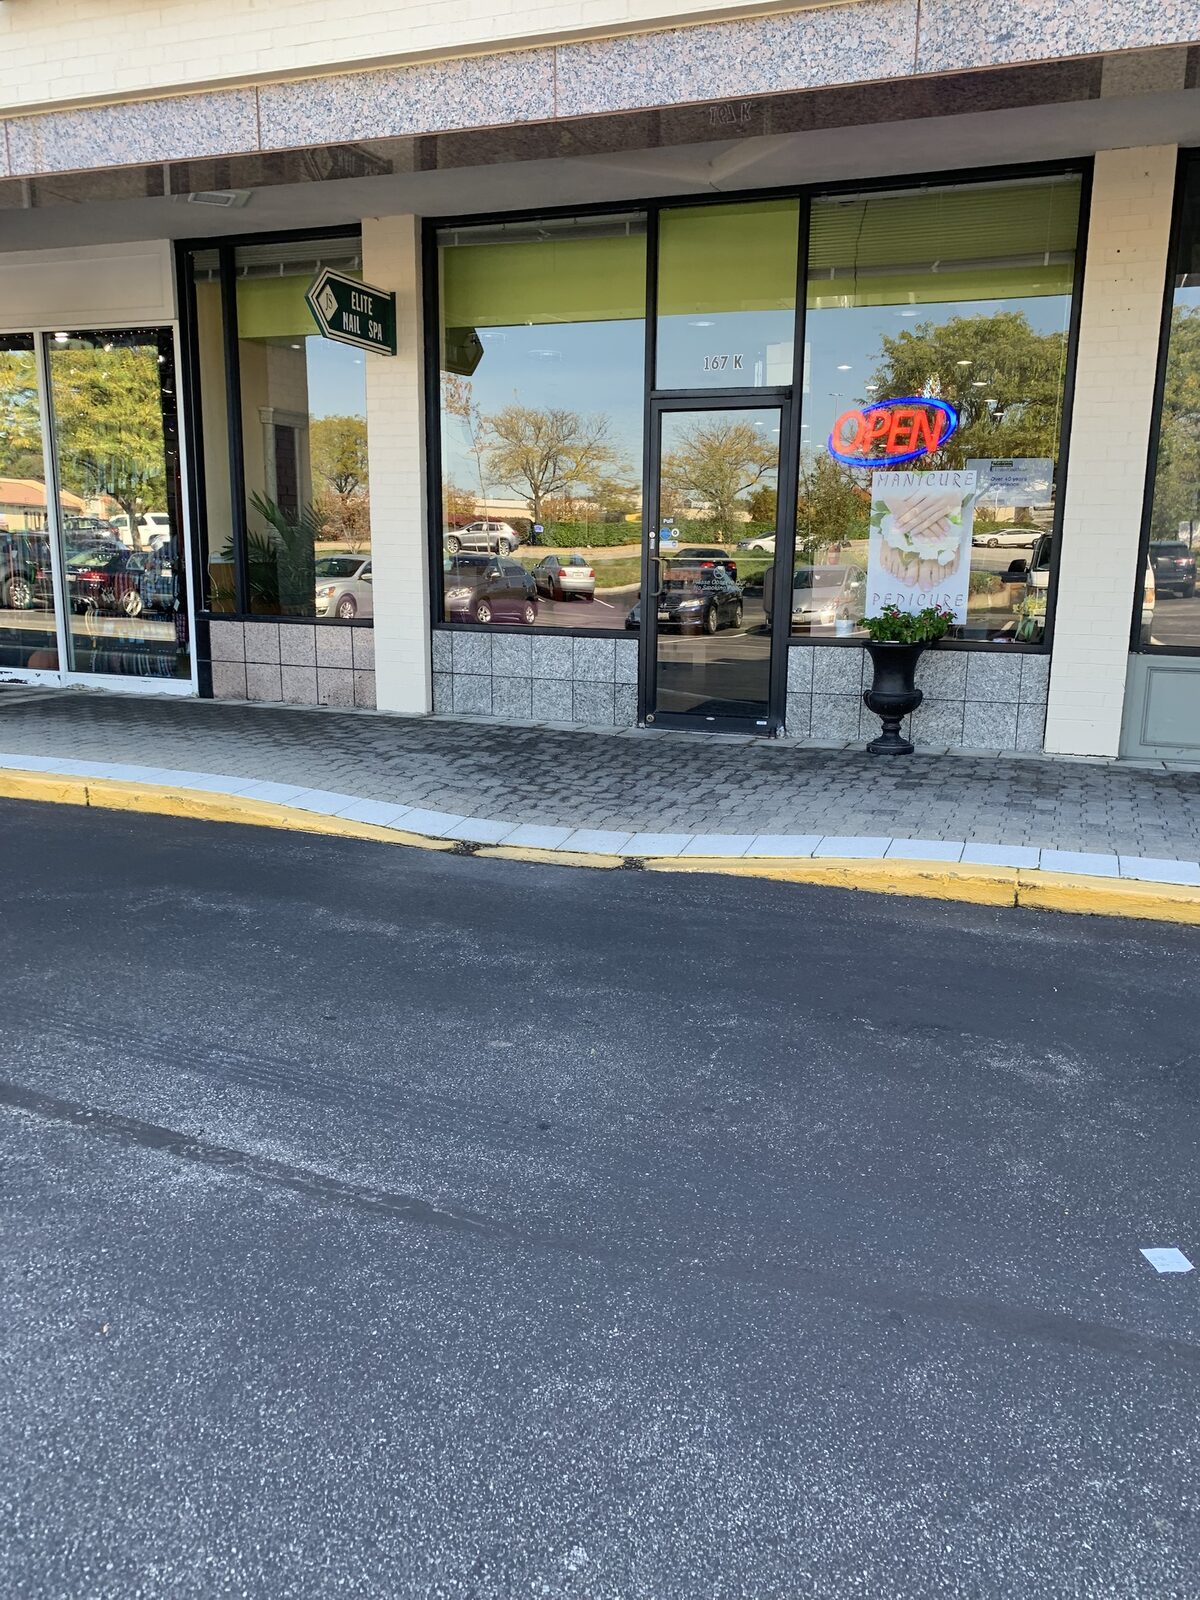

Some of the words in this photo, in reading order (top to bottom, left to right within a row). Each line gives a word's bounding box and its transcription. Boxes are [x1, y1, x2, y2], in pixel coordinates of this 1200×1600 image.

[351, 291, 373, 316] ELITE
[342, 311, 361, 334] NAIL
[368, 320, 383, 341] SPA
[703, 354, 729, 371] 167
[733, 353, 744, 370] K
[832, 408, 945, 454] OPEN
[877, 472, 975, 488] MANICURE
[872, 592, 964, 611] PEDICURE
